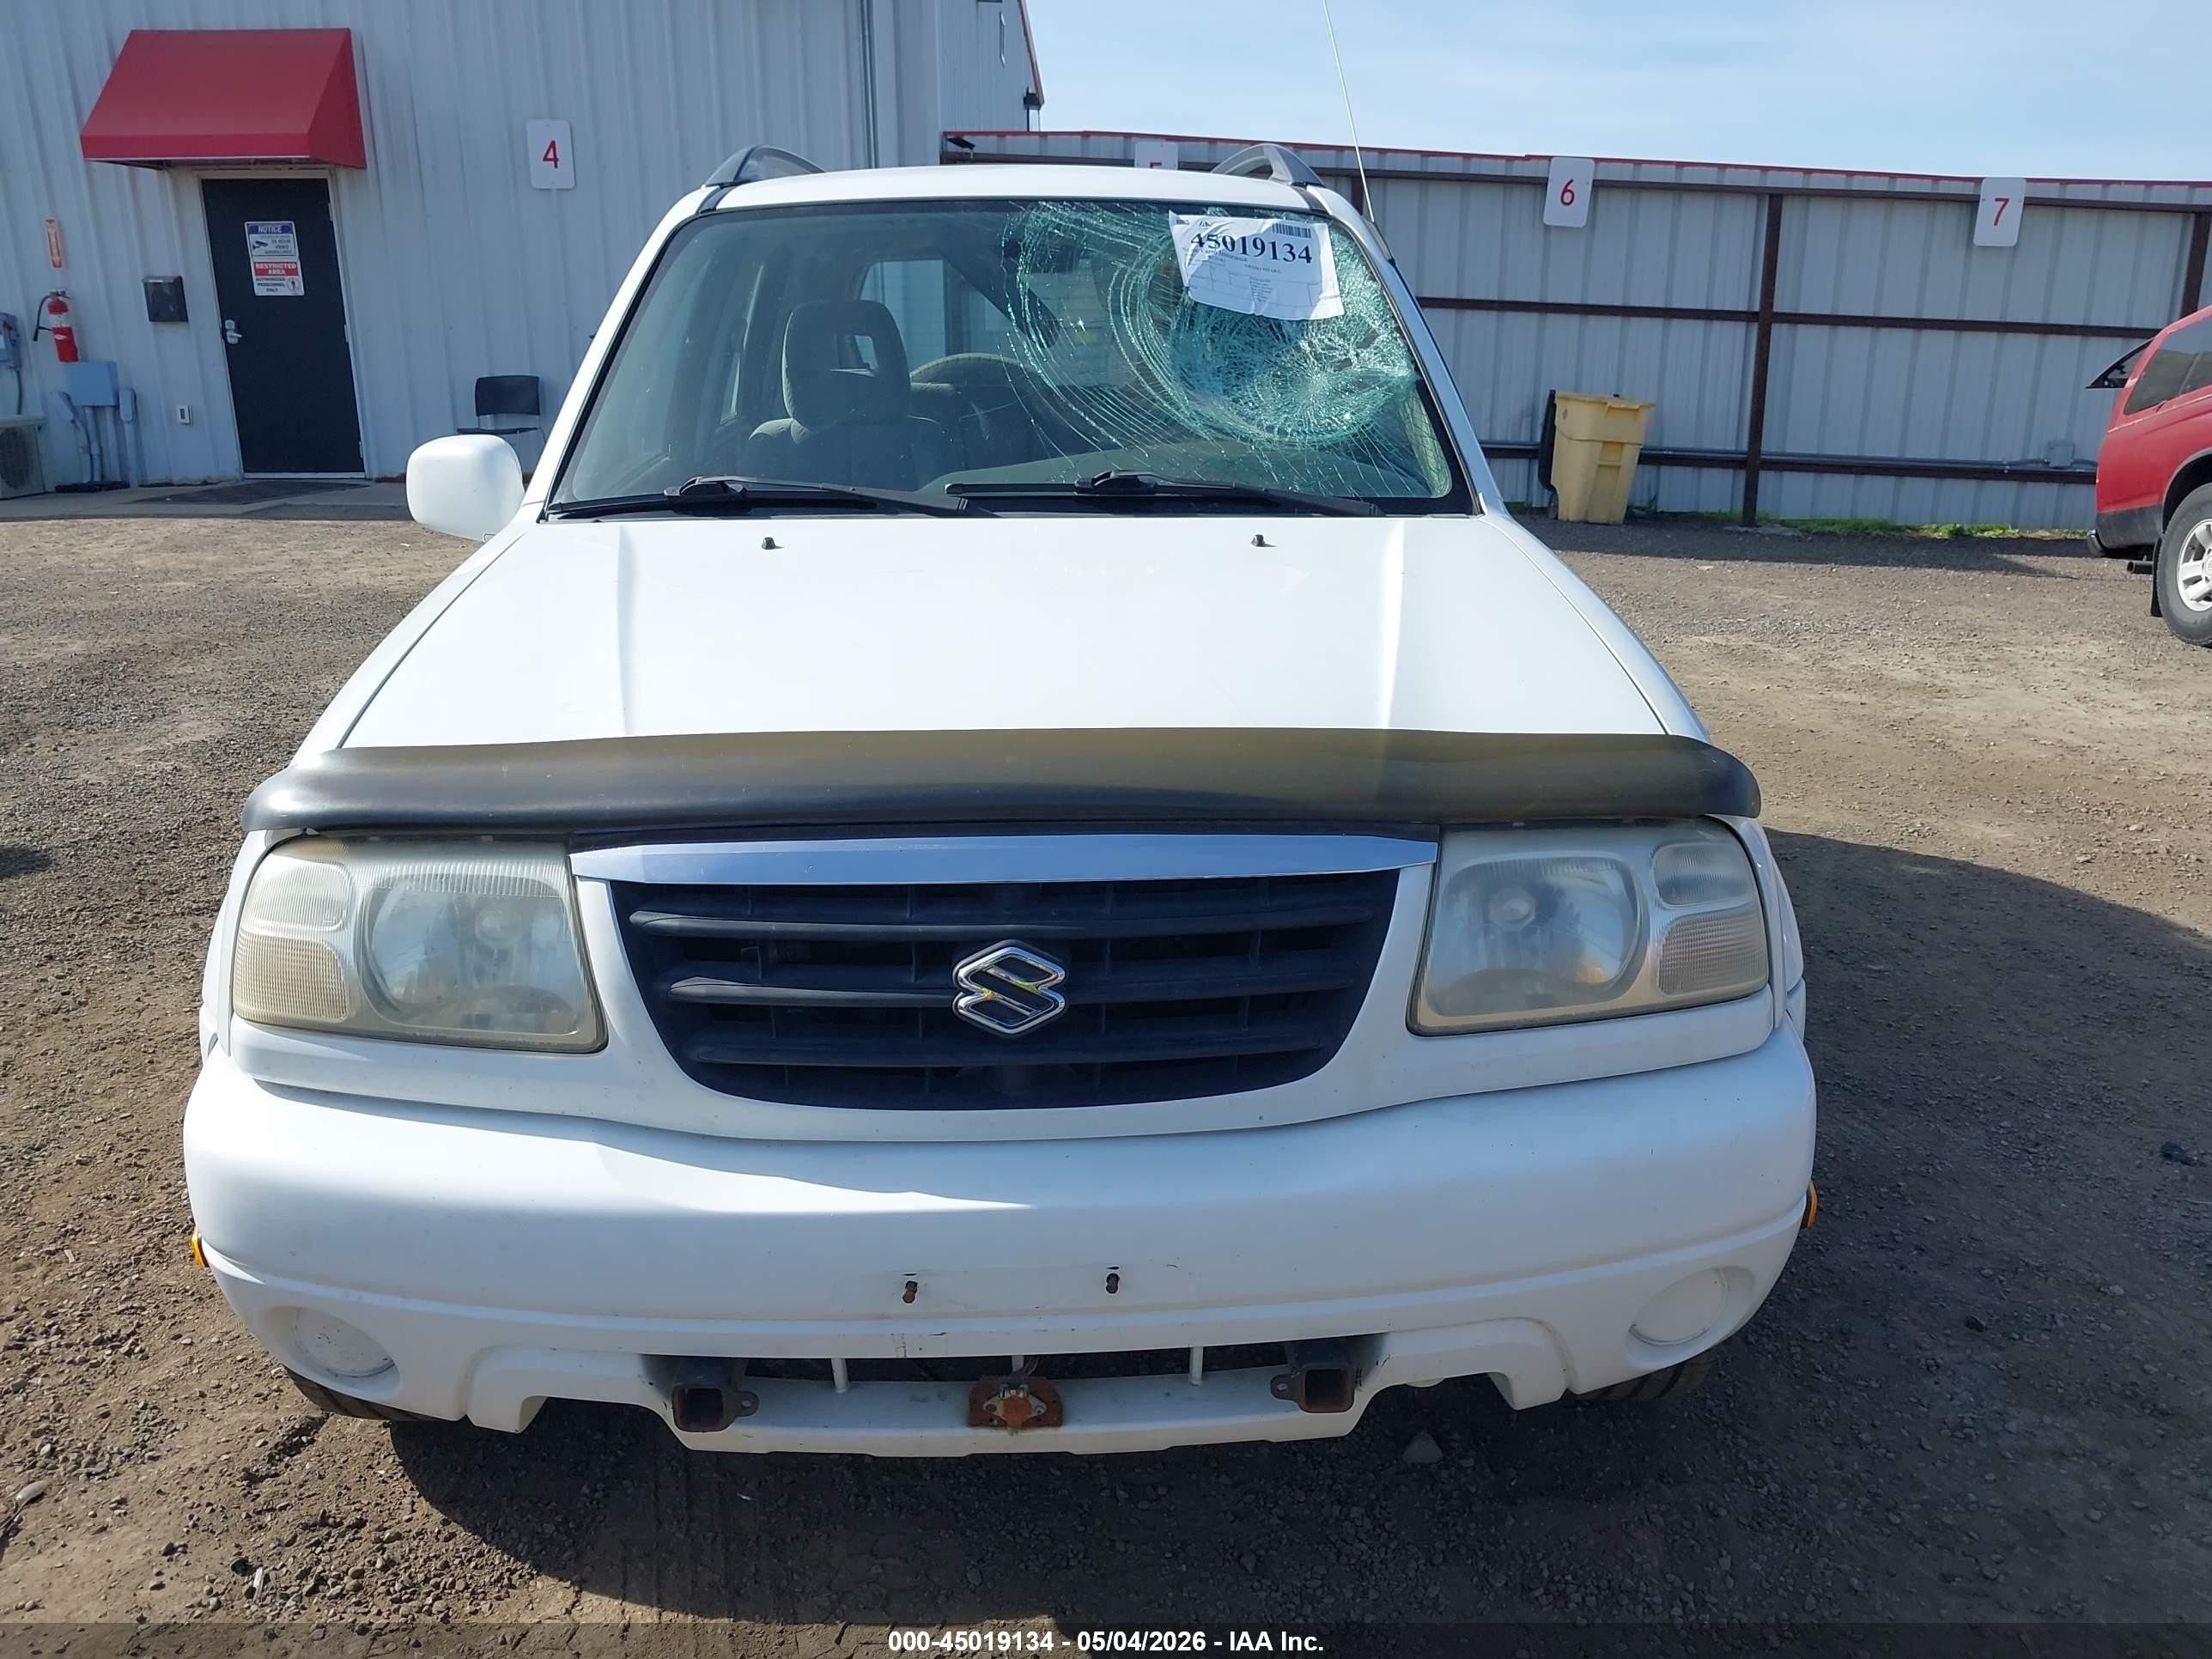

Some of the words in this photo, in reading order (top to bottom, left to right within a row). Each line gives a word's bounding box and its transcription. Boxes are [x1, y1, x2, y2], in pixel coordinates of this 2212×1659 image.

[543, 140, 559, 169] 4
[1559, 179, 1576, 207] 6
[1993, 198, 2010, 226] 7
[1190, 233, 1313, 264] 45019134
